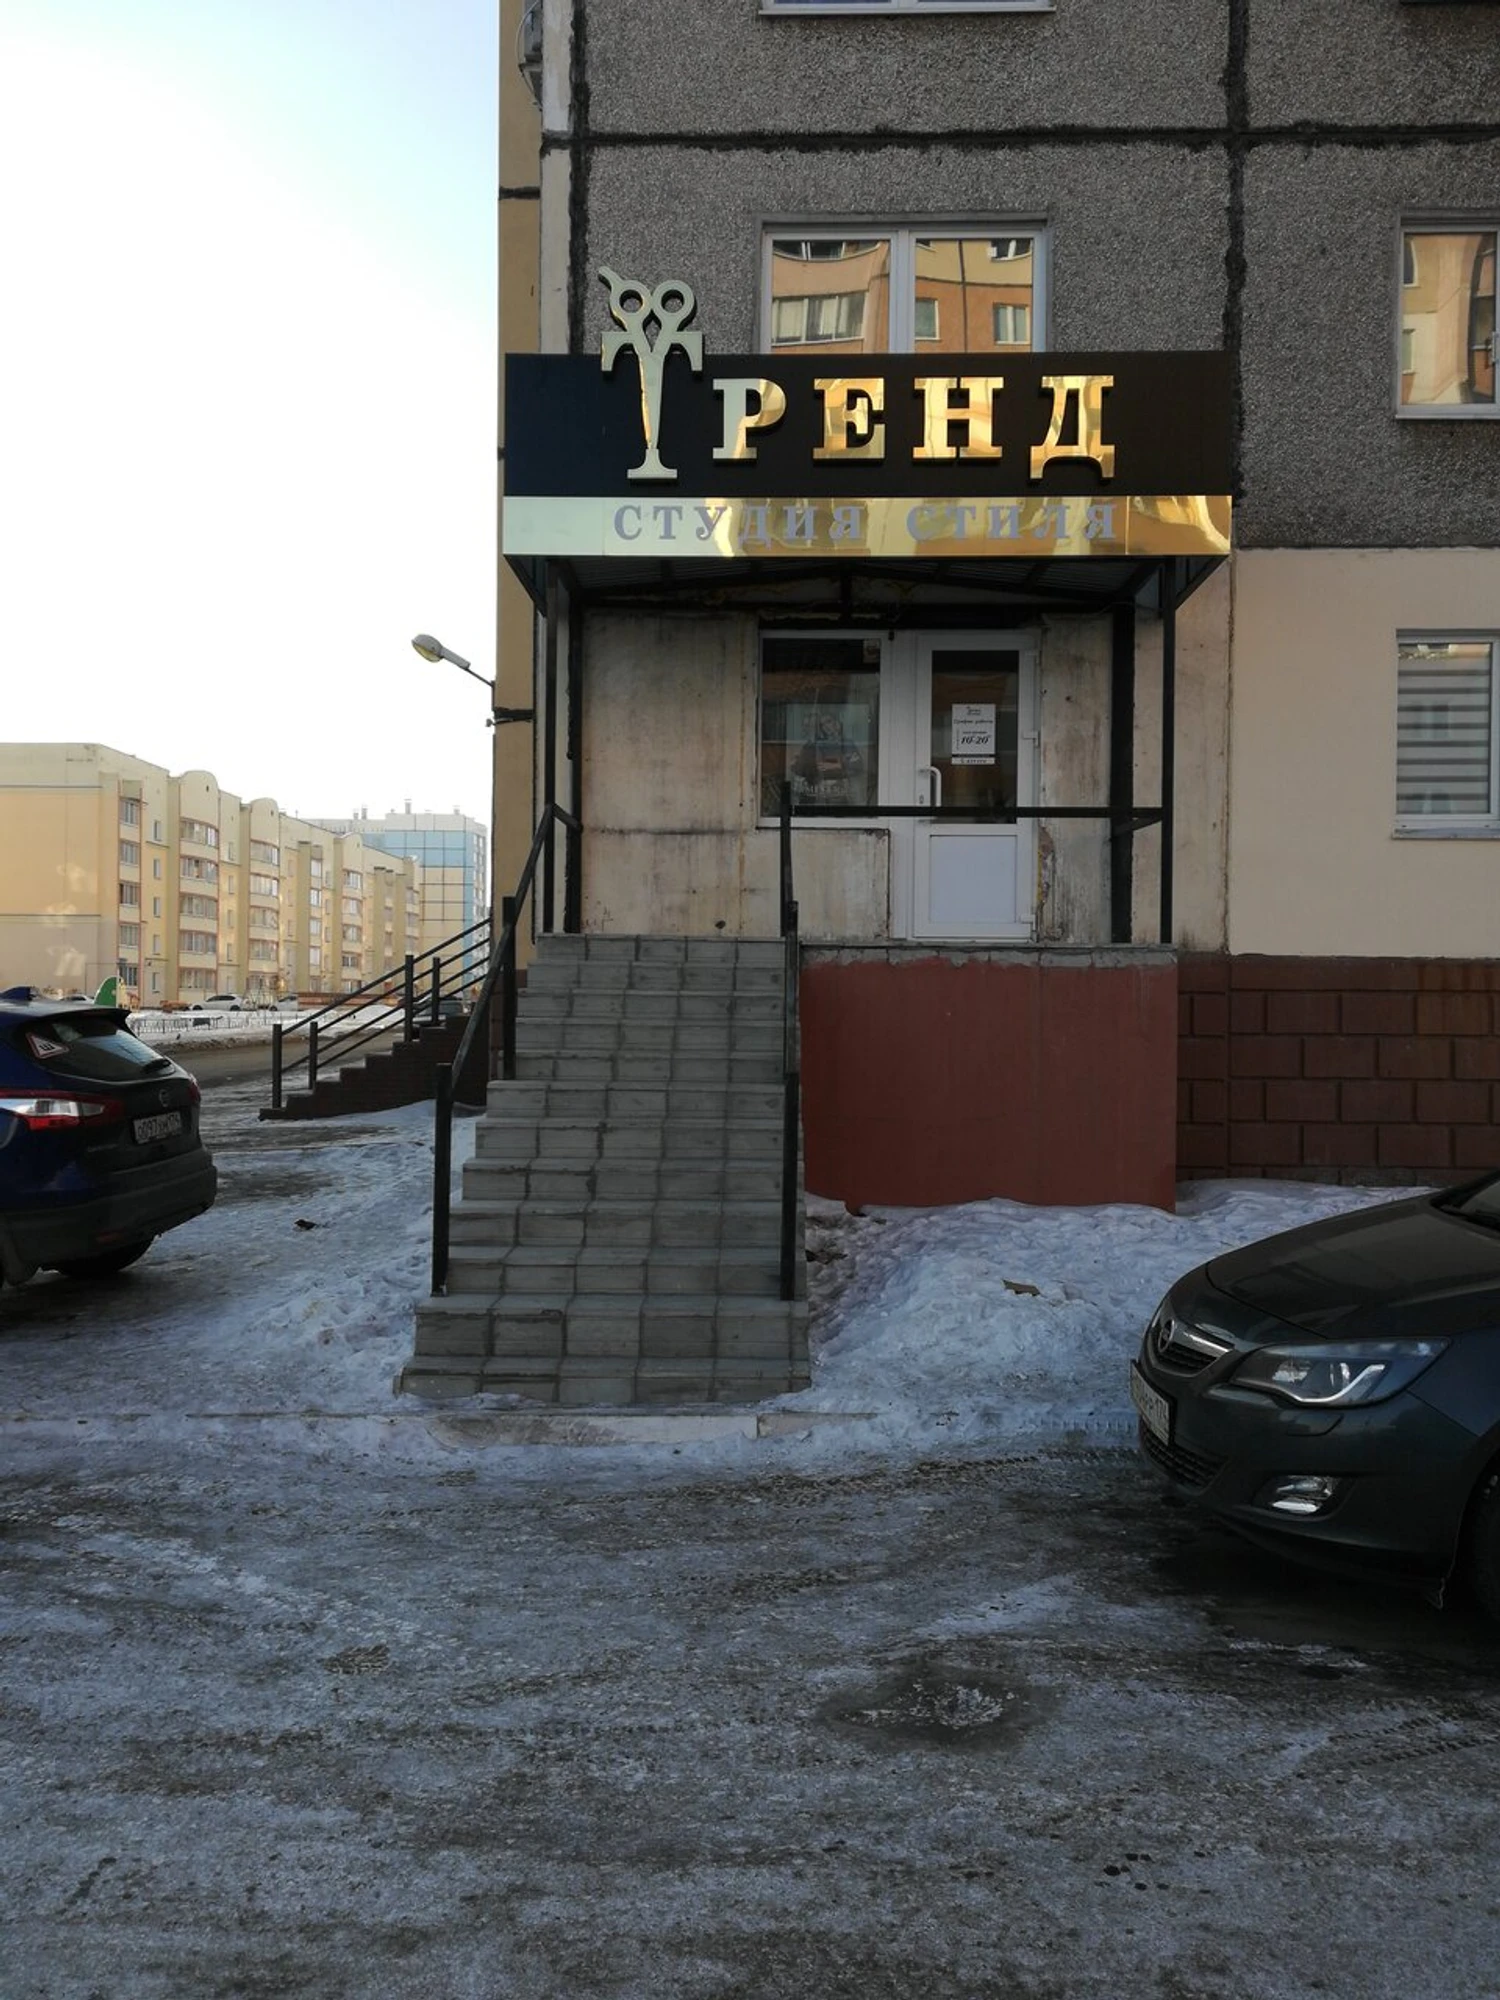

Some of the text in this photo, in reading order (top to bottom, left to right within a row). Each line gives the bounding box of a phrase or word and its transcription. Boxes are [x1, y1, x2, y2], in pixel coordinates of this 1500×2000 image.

[599, 331, 1117, 480] ТРЕНД
[613, 504, 1117, 546] СТУДИЯ СТИЛЯ
